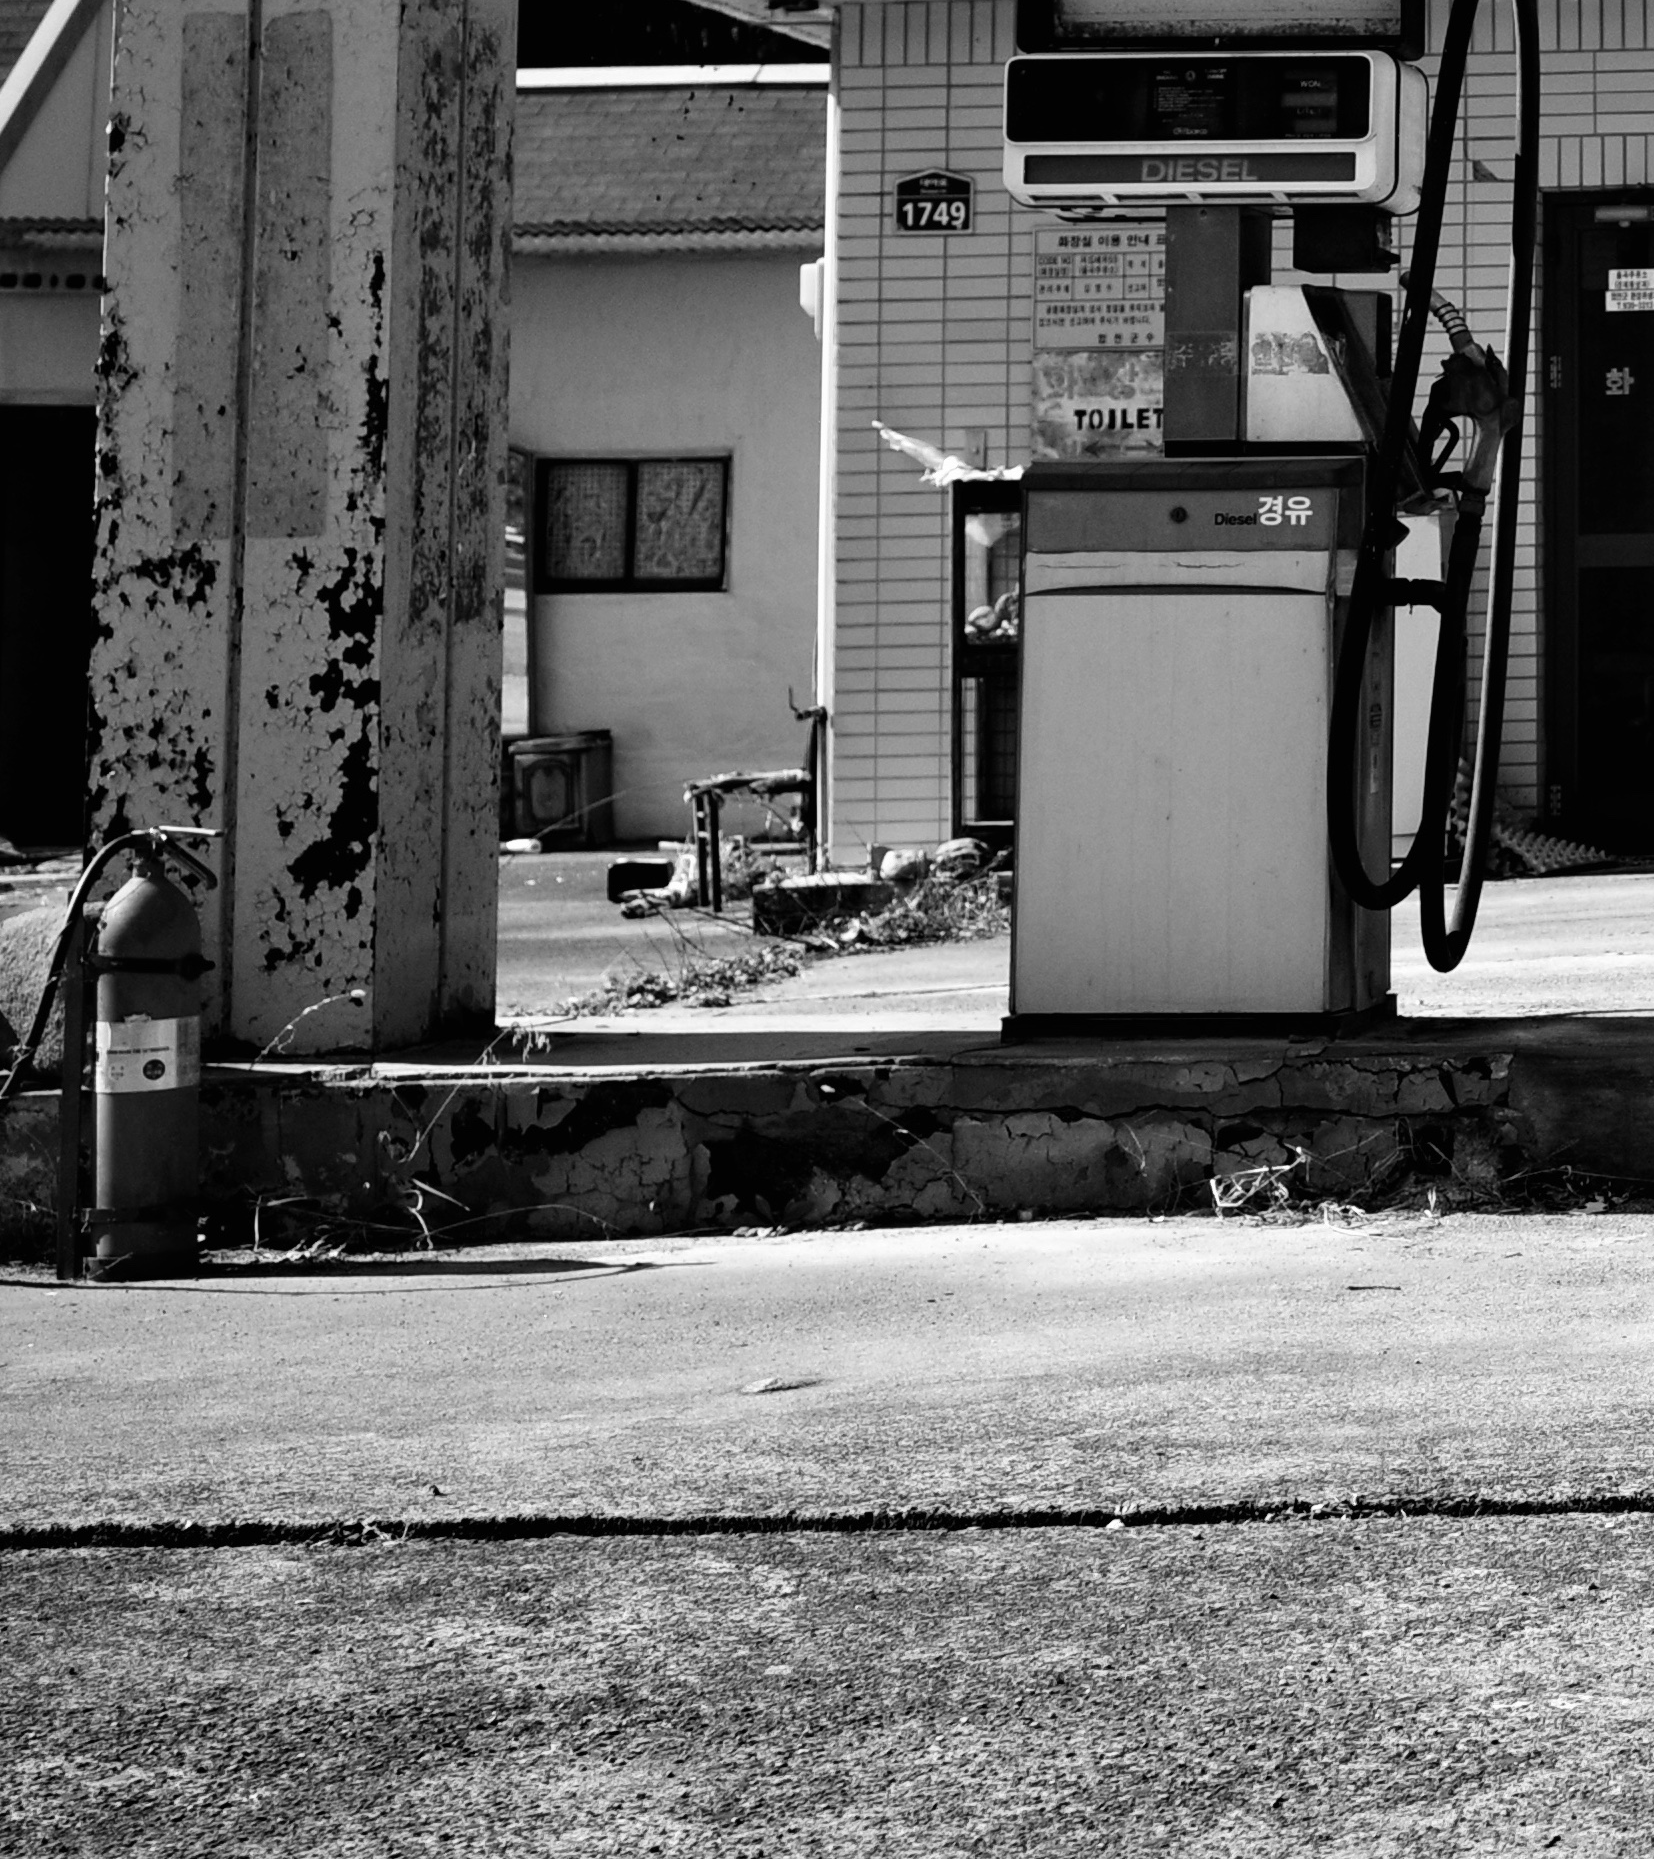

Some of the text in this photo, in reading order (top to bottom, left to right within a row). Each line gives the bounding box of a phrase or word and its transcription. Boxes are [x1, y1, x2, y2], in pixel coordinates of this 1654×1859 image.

[1300, 80, 1321, 88] WON
[1141, 159, 1258, 182] DIESEL
[902, 201, 966, 228] 1749
[1058, 235, 1092, 247] 화장실
[1098, 234, 1120, 247] 이용
[1127, 234, 1149, 246] 안내
[1074, 408, 1164, 431] TOILET
[1214, 495, 1314, 526] Diesel 경유
